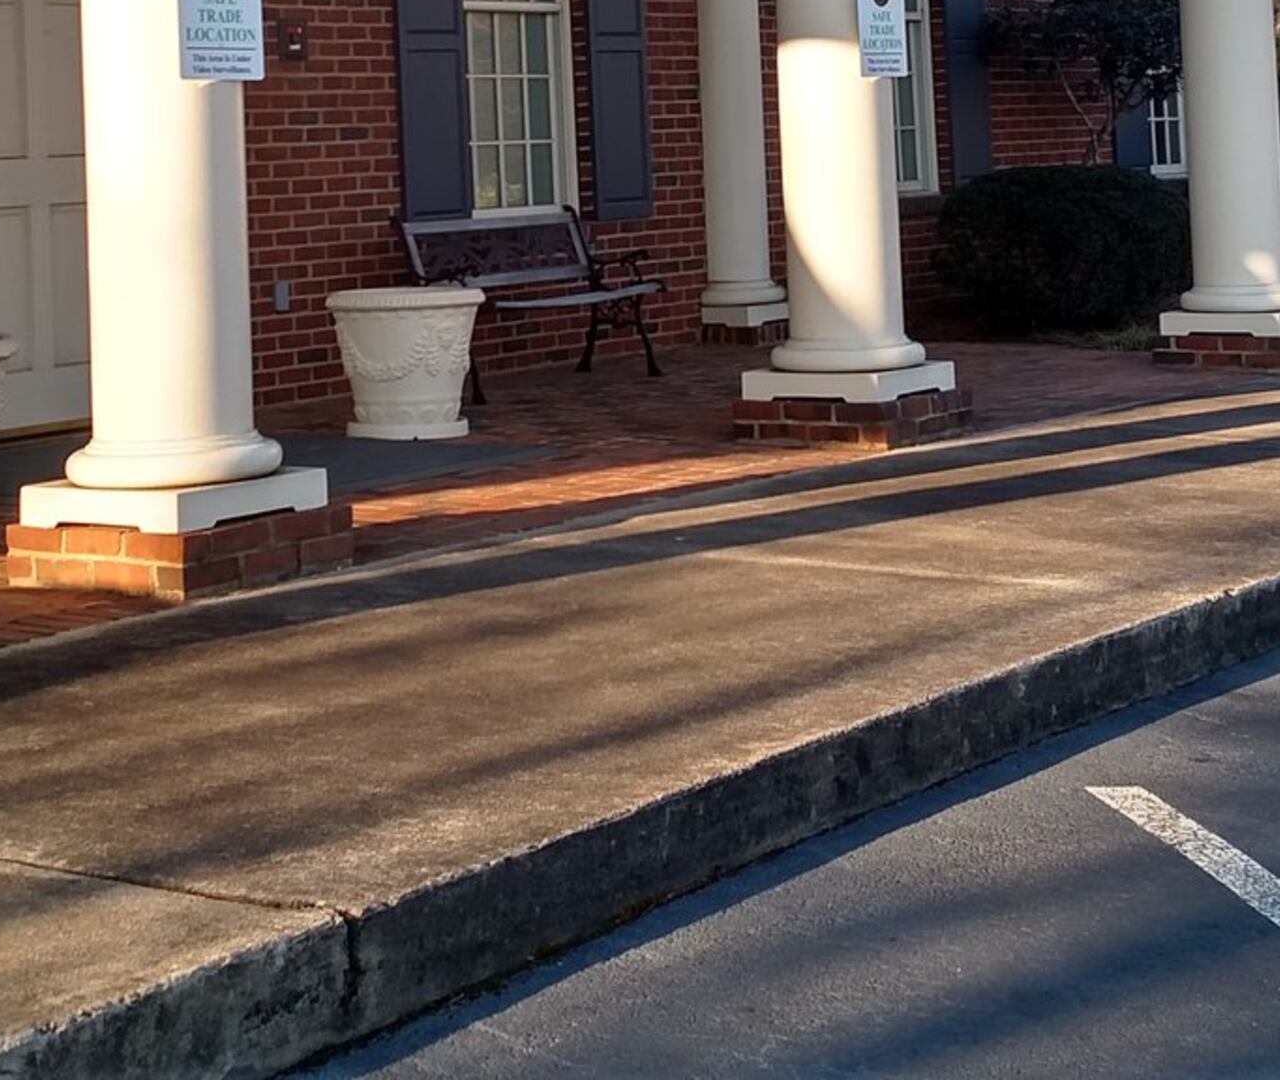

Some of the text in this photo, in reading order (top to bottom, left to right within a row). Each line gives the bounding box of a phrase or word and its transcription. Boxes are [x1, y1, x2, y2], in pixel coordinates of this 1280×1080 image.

[197, 9, 244, 24] TRADE
[871, 11, 892, 22] SAFE
[186, 27, 256, 42] LOCATION
[869, 24, 896, 36] TRADE
[862, 39, 903, 50] LOCATION
